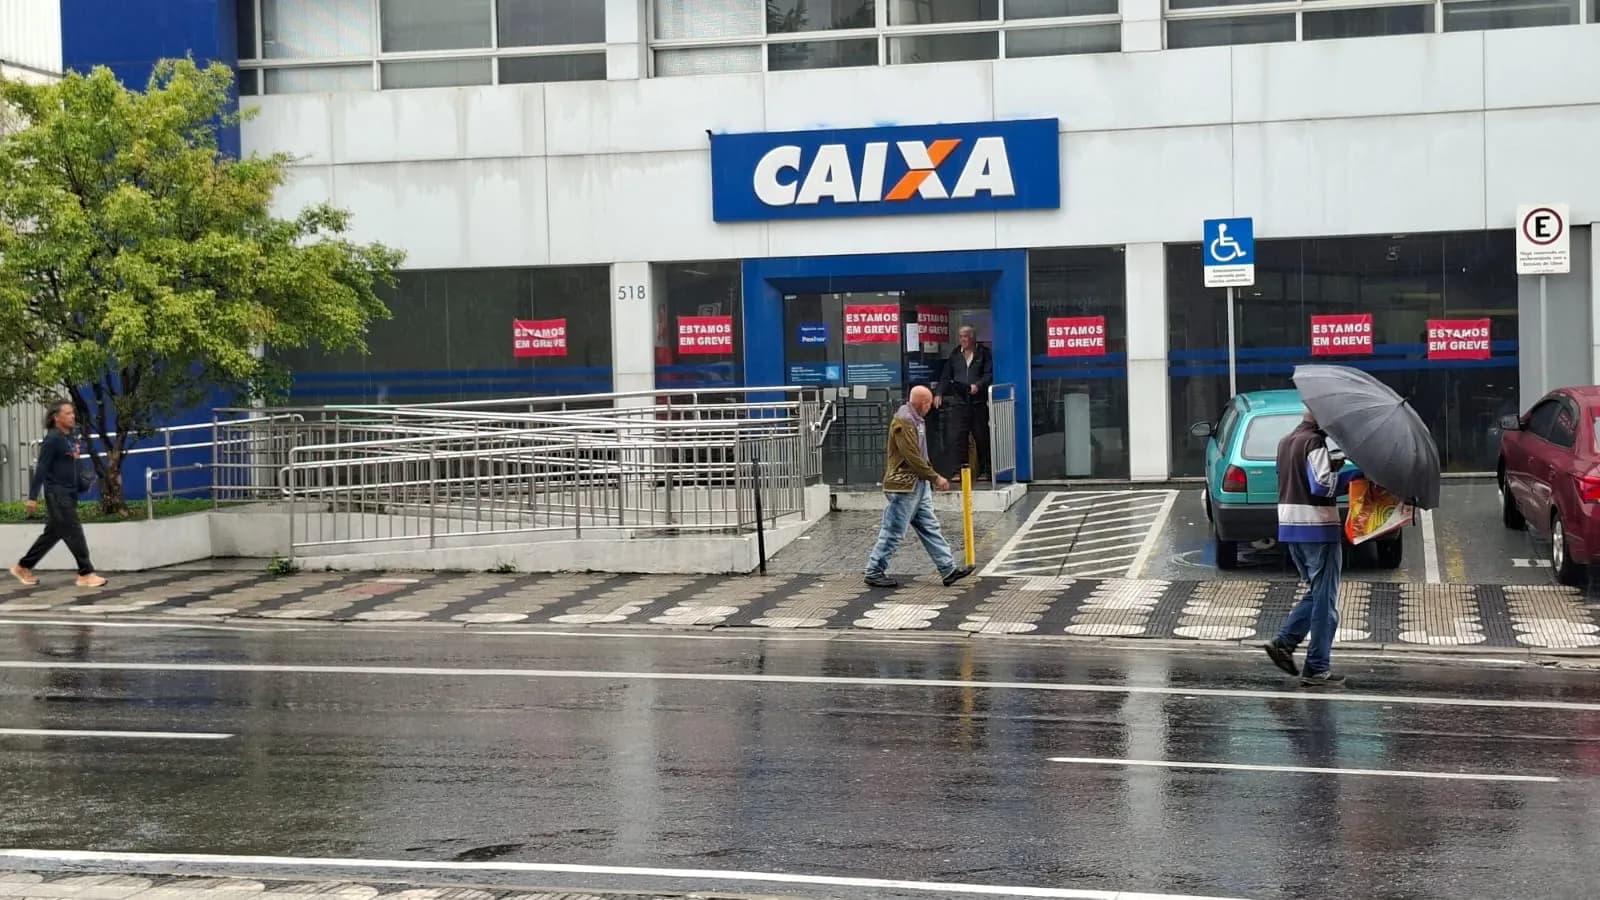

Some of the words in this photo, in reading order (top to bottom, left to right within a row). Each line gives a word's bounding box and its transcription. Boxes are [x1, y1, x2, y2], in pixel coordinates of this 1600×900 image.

[753, 136, 1016, 206] CAIXA
[1535, 215, 1551, 238] E
[618, 285, 646, 300] 518
[846, 313, 898, 322] ESTAMOS
[514, 327, 565, 337] ESTAMOS
[679, 324, 731, 333] ESTAMOS
[846, 325, 861, 334] EM
[864, 325, 898, 334] GREVE
[1048, 326, 1104, 336] ESTAMOS
[1312, 323, 1371, 333] ESTAMOS
[1429, 328, 1488, 338] ESTAMOS
[515, 340, 530, 348] EM
[532, 338, 566, 348] GREVE
[680, 337, 695, 345] EM
[697, 336, 732, 345] GREVE
[1049, 339, 1065, 348] EM
[1067, 337, 1104, 348] GREVE
[1313, 337, 1330, 346] EM
[1332, 336, 1372, 346] GREVE
[1429, 341, 1447, 351] EM
[1449, 340, 1489, 350] GREVE
